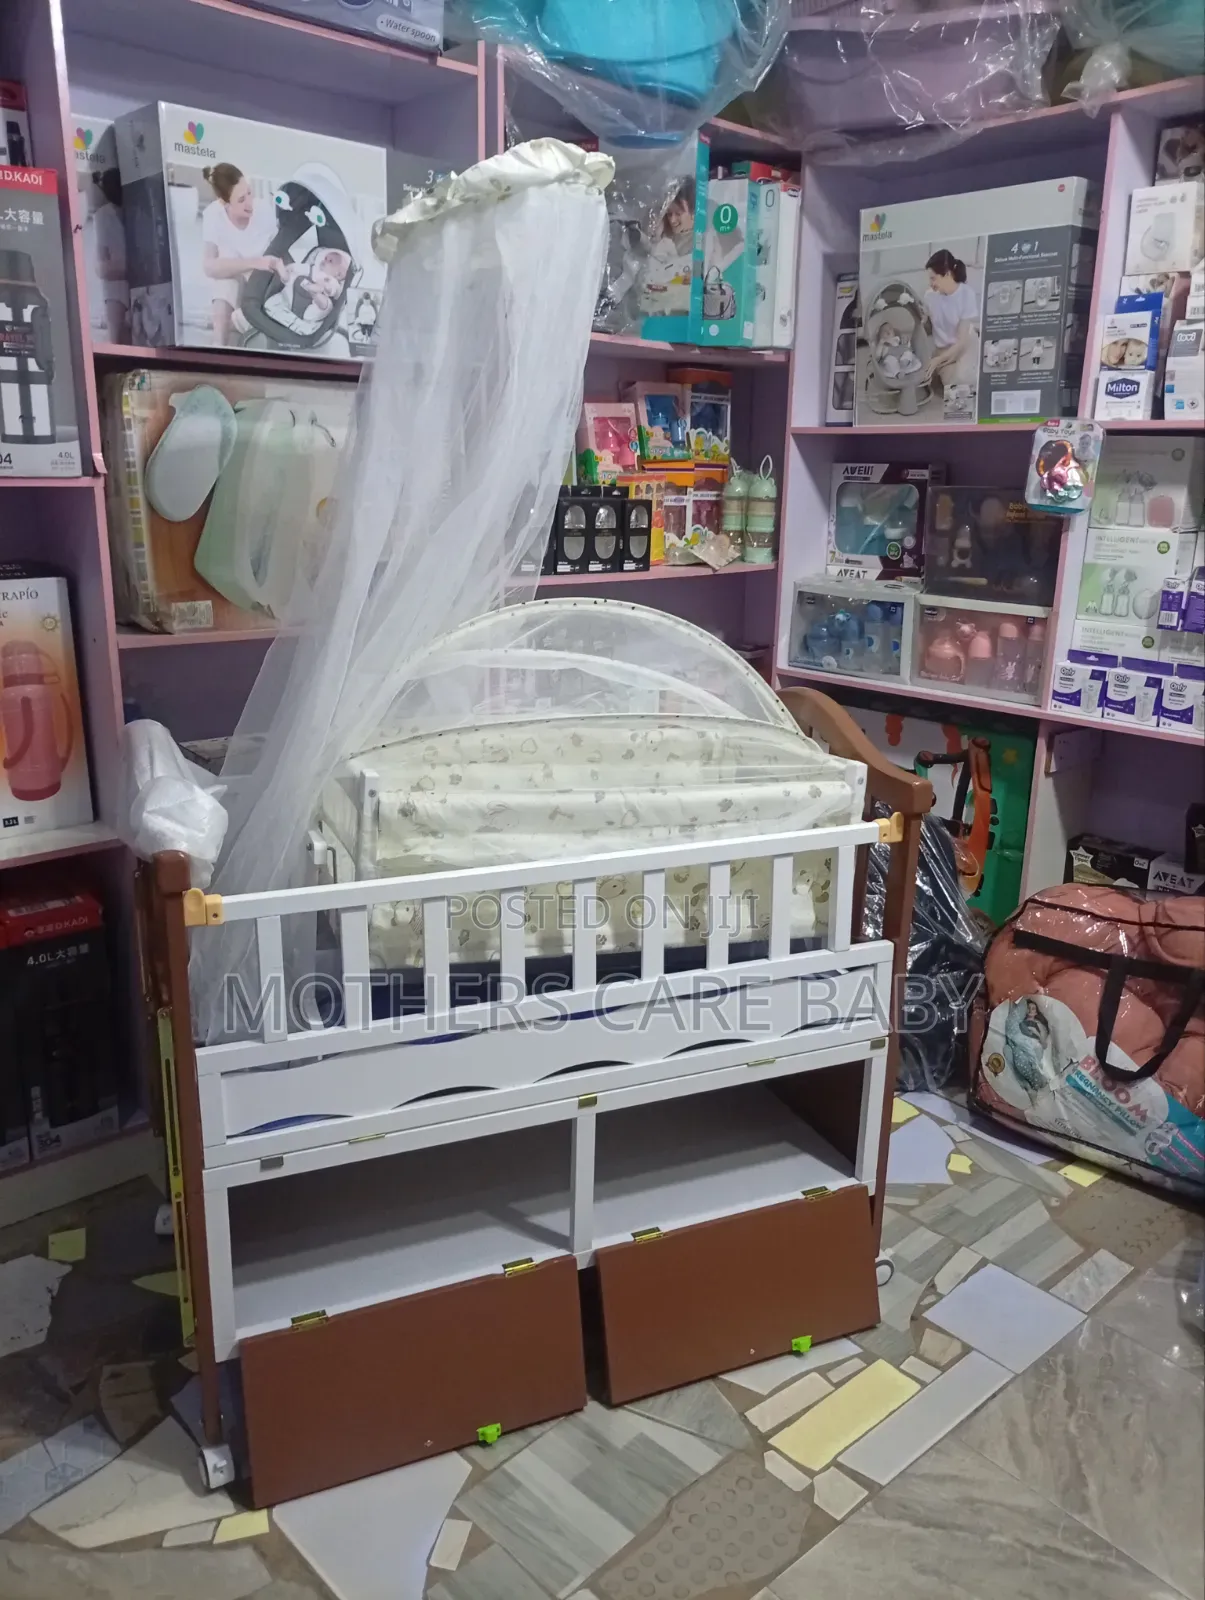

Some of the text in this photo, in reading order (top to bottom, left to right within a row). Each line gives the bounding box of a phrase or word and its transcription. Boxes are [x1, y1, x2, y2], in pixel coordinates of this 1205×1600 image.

[385, 18, 437, 42] Water spoon
[174, 141, 217, 159] mastela
[862, 229, 893, 243] mastela
[1107, 383, 1138, 394] Milton
[57, 450, 75, 460] 4.0L
[0, 586, 39, 601] RAPÍO
[1060, 666, 1077, 678] Only
[1114, 673, 1132, 685] Only
[1169, 681, 1188, 693] Only
[1153, 869, 1196, 889] AVEAT
[1078, 1054, 1149, 1124] BLOOM
